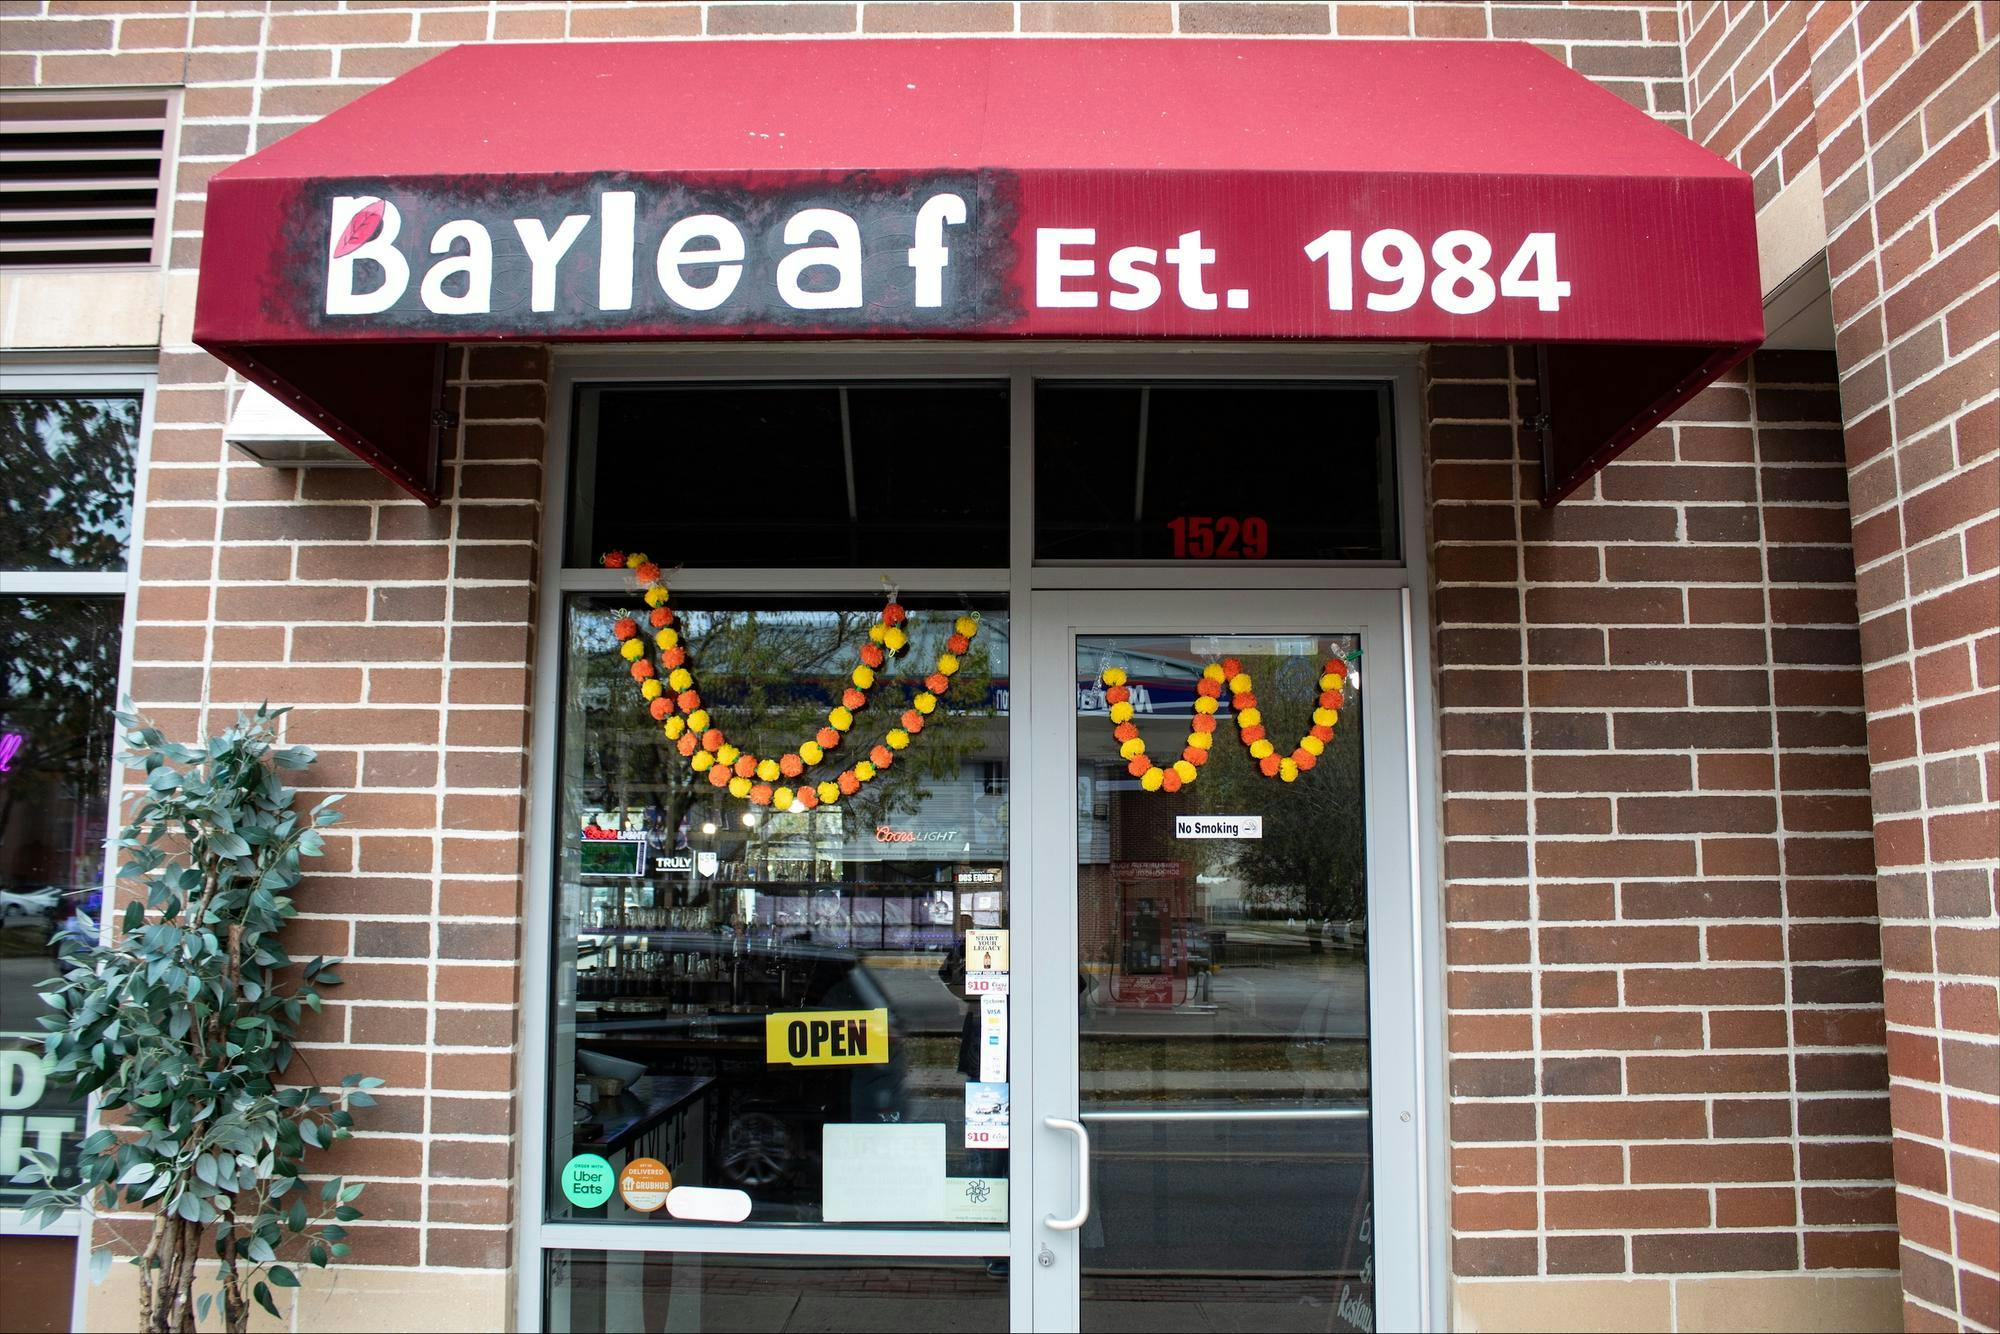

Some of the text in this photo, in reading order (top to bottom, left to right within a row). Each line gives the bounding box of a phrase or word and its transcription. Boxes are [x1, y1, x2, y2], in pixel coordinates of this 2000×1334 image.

[1034, 227, 1250, 312] Est.
[1303, 228, 1571, 315] 1984
[1167, 515, 1268, 559] 1529
[876, 825, 957, 843] Coors LIGHT
[1178, 822, 1239, 837] No Smoking
[656, 856, 692, 868] TRULY
[958, 873, 973, 882] DOS
[967, 981, 989, 991] $10
[788, 1019, 867, 1058] OPEN
[967, 1132, 989, 1142] $10
[573, 1170, 603, 1182] Uber
[628, 1168, 664, 1176] DELIVERED
[573, 1183, 603, 1195] Eats
[635, 1181, 670, 1190] GRUBHUB
